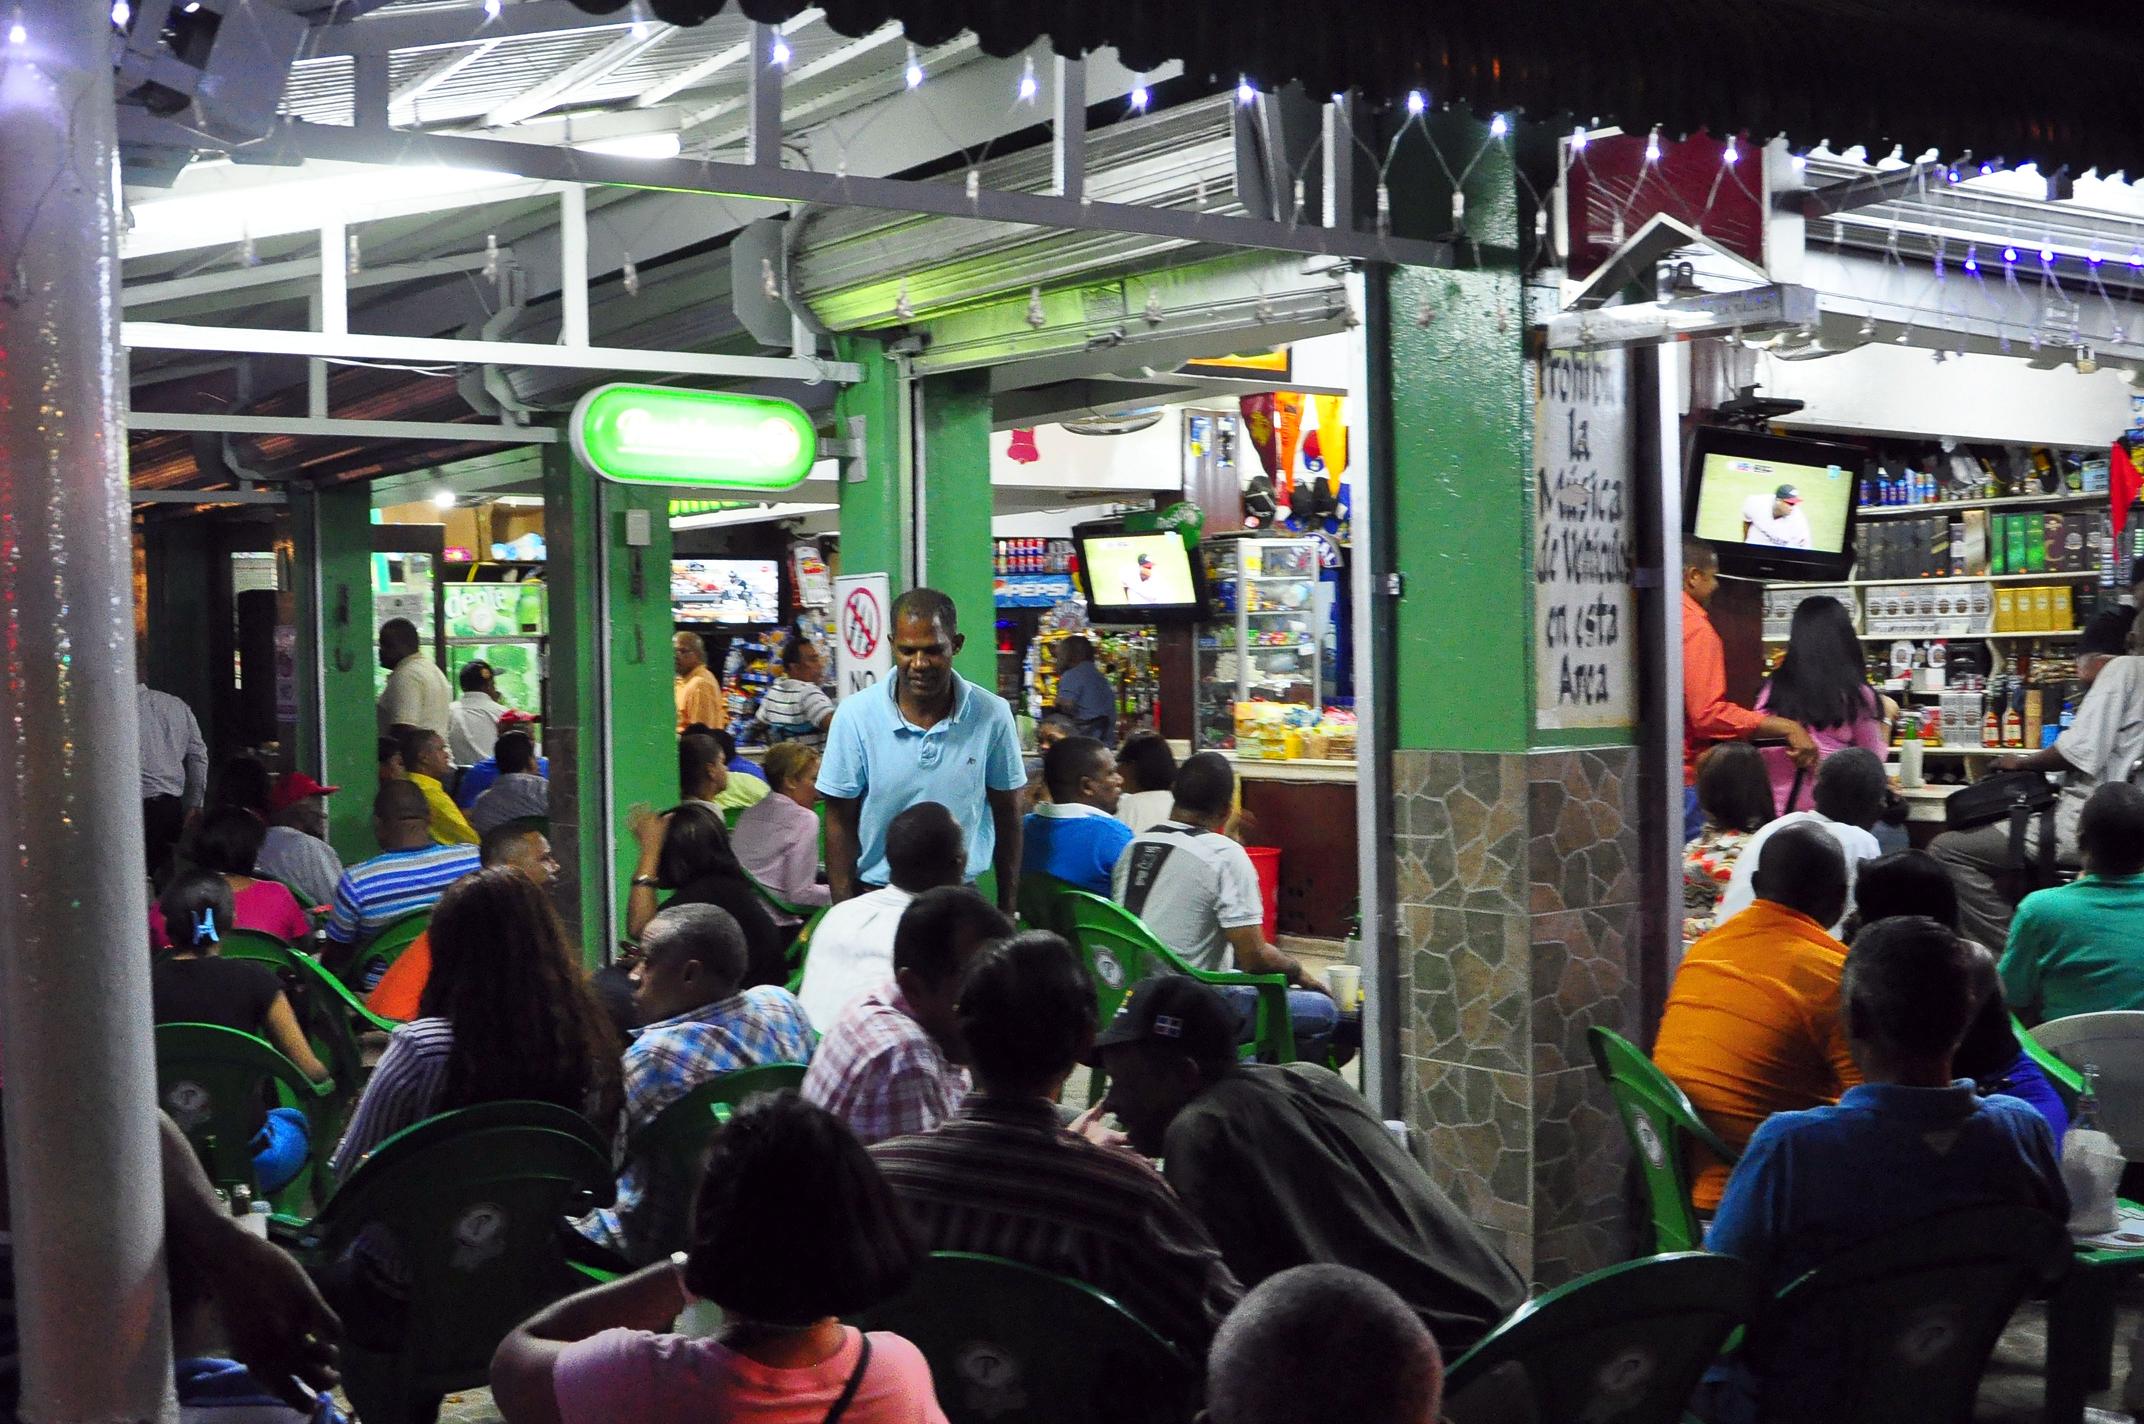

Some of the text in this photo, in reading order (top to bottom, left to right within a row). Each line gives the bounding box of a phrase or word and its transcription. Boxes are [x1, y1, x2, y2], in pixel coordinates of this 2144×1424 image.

[1007, 582, 1070, 597] PEPSI
[1547, 604, 1568, 648] en
[849, 671, 877, 696] NO
[1558, 653, 1609, 705] Area
